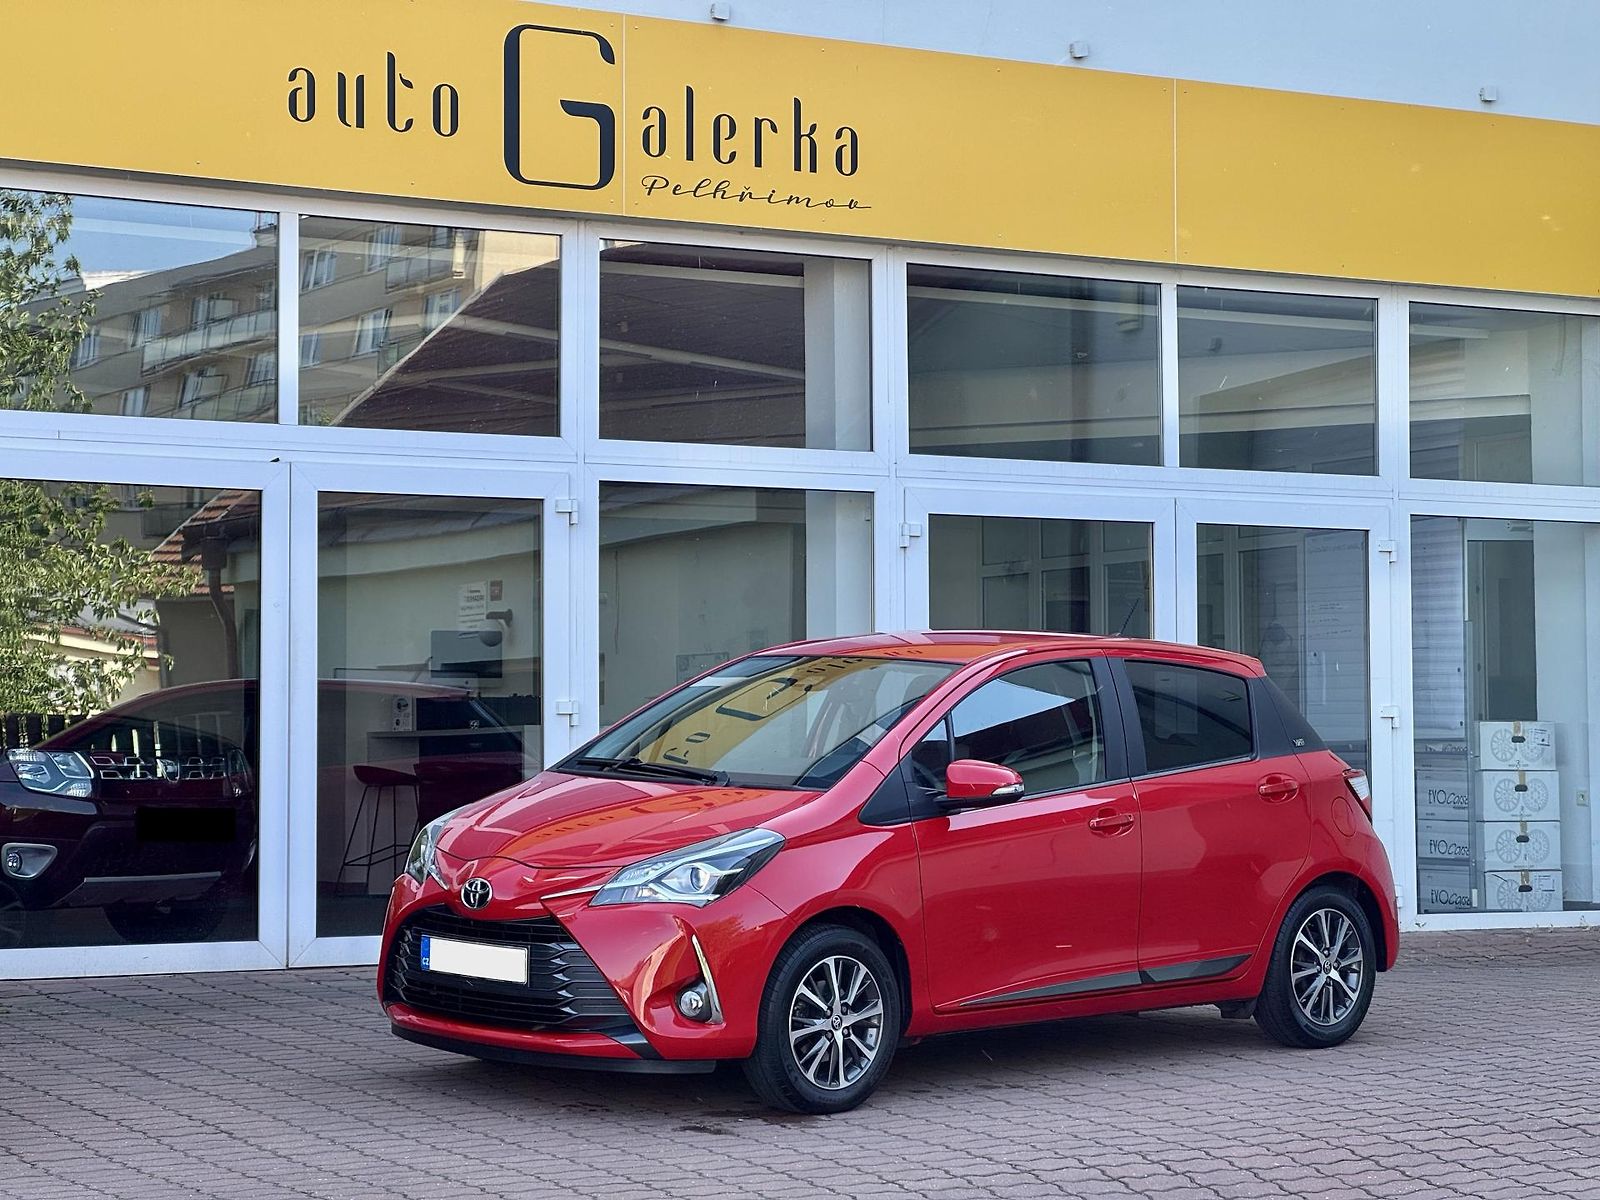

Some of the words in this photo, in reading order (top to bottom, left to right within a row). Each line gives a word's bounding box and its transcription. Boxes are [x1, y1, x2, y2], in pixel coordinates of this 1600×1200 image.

[288, 51, 460, 138] auto
[503, 23, 860, 191] Galerka
[641, 174, 872, 210] Pelhřimov
[422, 957, 429, 966] CZ
